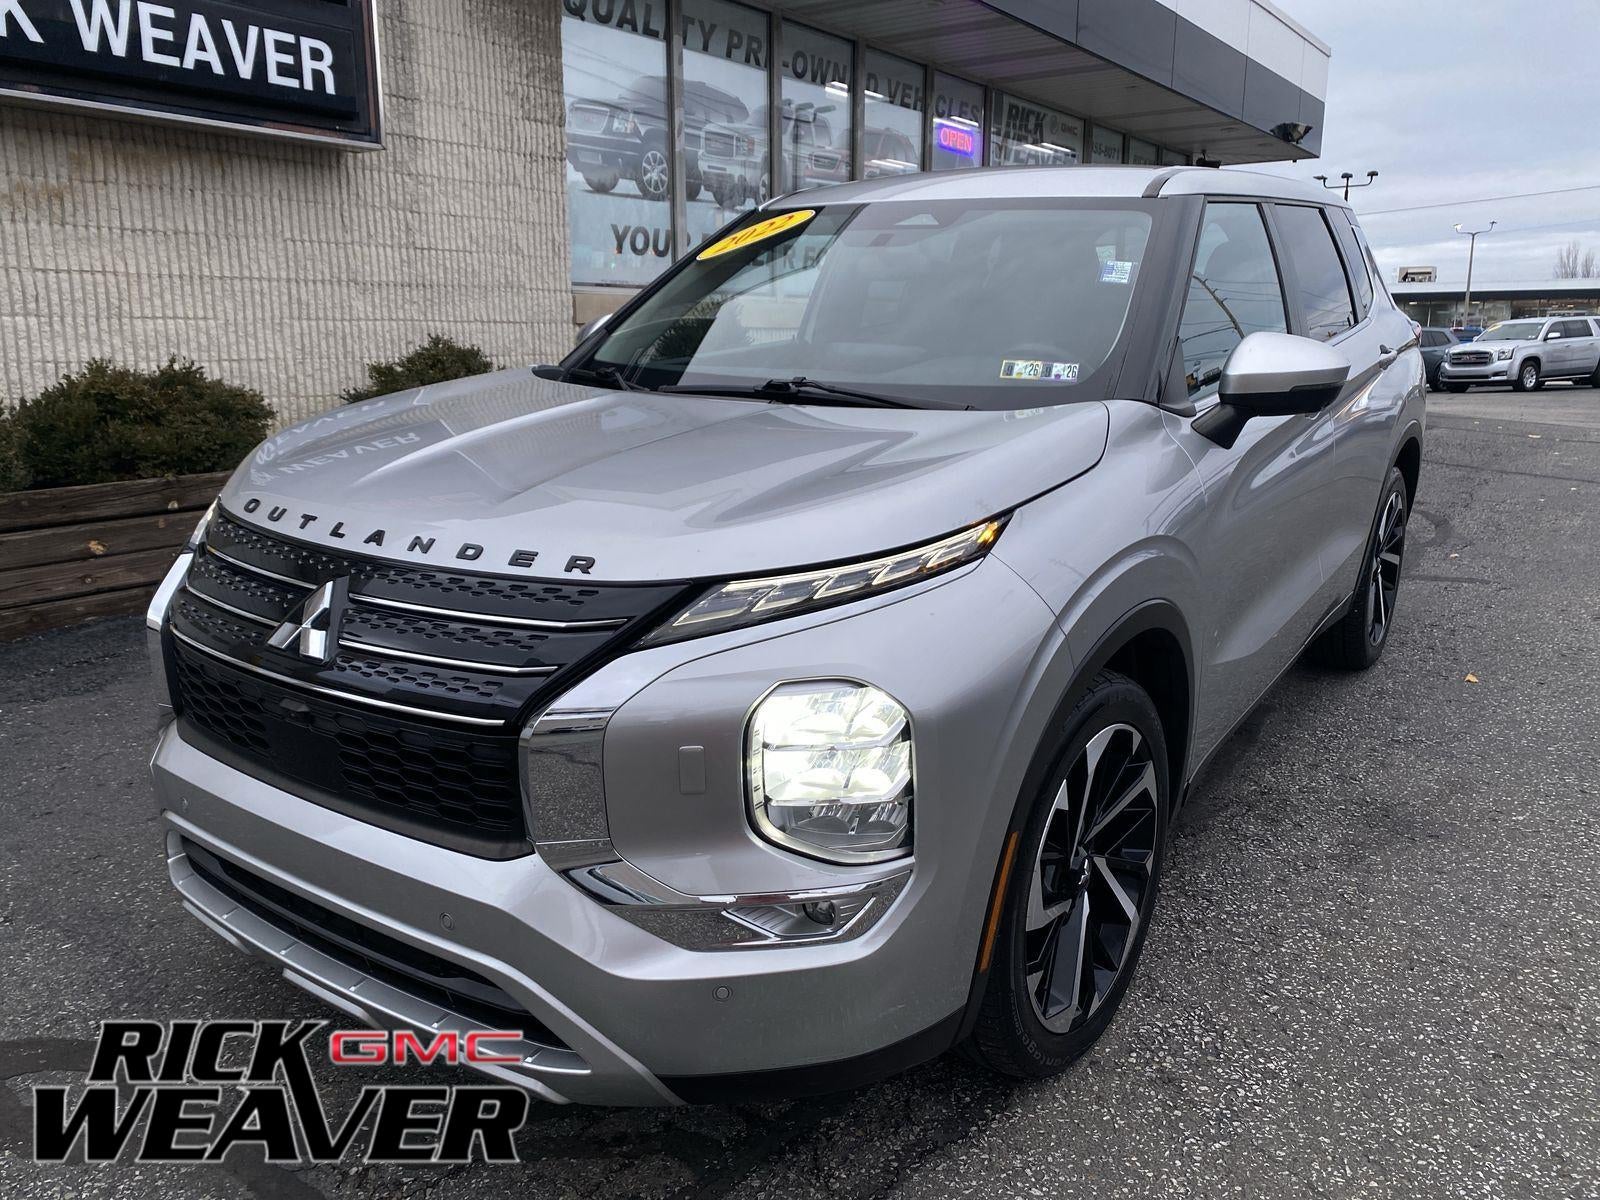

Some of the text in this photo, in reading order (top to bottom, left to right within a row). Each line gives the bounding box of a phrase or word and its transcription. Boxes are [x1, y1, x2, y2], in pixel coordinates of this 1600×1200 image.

[69, 0, 336, 95] WEAVER
[563, 0, 718, 52] QUALTY
[940, 127, 972, 155] OPEN
[610, 223, 691, 258] YOU
[1028, 363, 1040, 376] 26
[1066, 365, 1078, 378] 26
[243, 498, 596, 575] OUTLANDER
